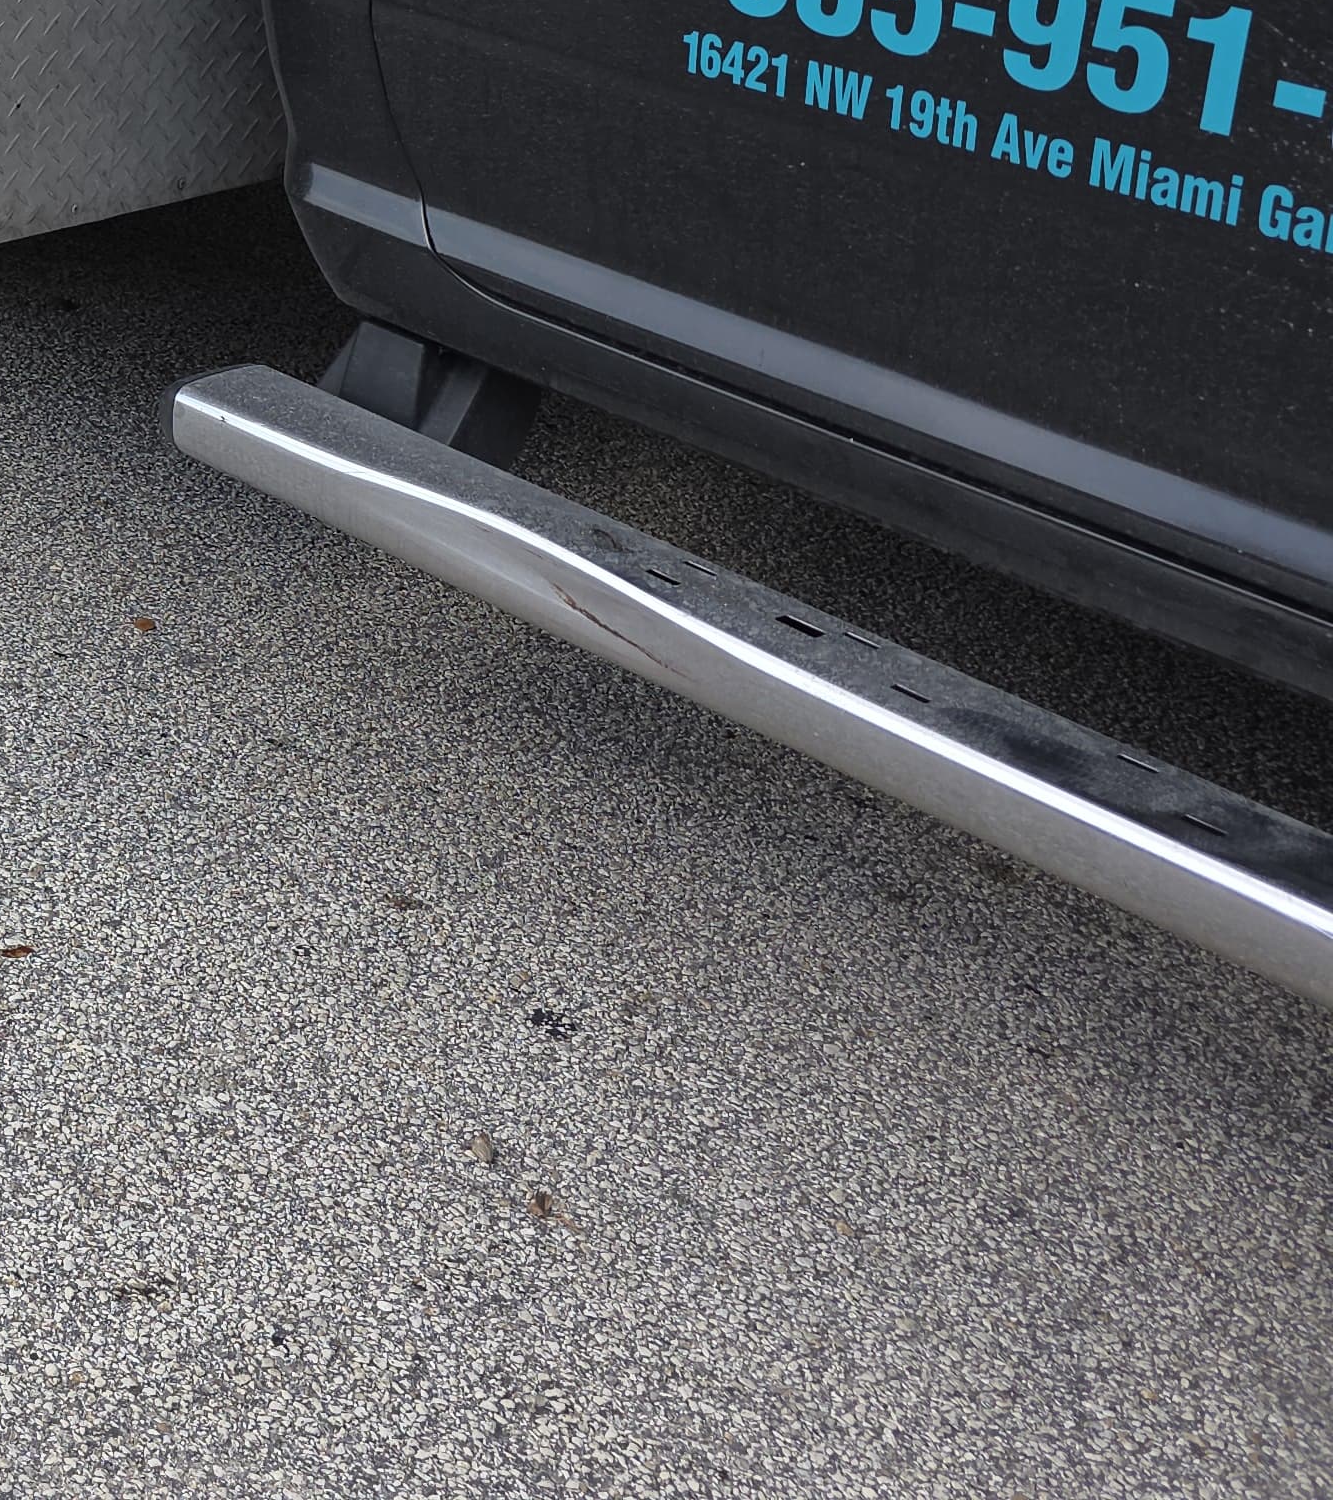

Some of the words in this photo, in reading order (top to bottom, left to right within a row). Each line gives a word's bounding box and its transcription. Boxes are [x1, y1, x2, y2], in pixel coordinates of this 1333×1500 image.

[682, 30, 789, 98] 16421
[805, 59, 873, 120] NW
[886, 84, 978, 152] 19th
[991, 112, 1074, 179] Ave
[1088, 138, 1244, 227] Miami
